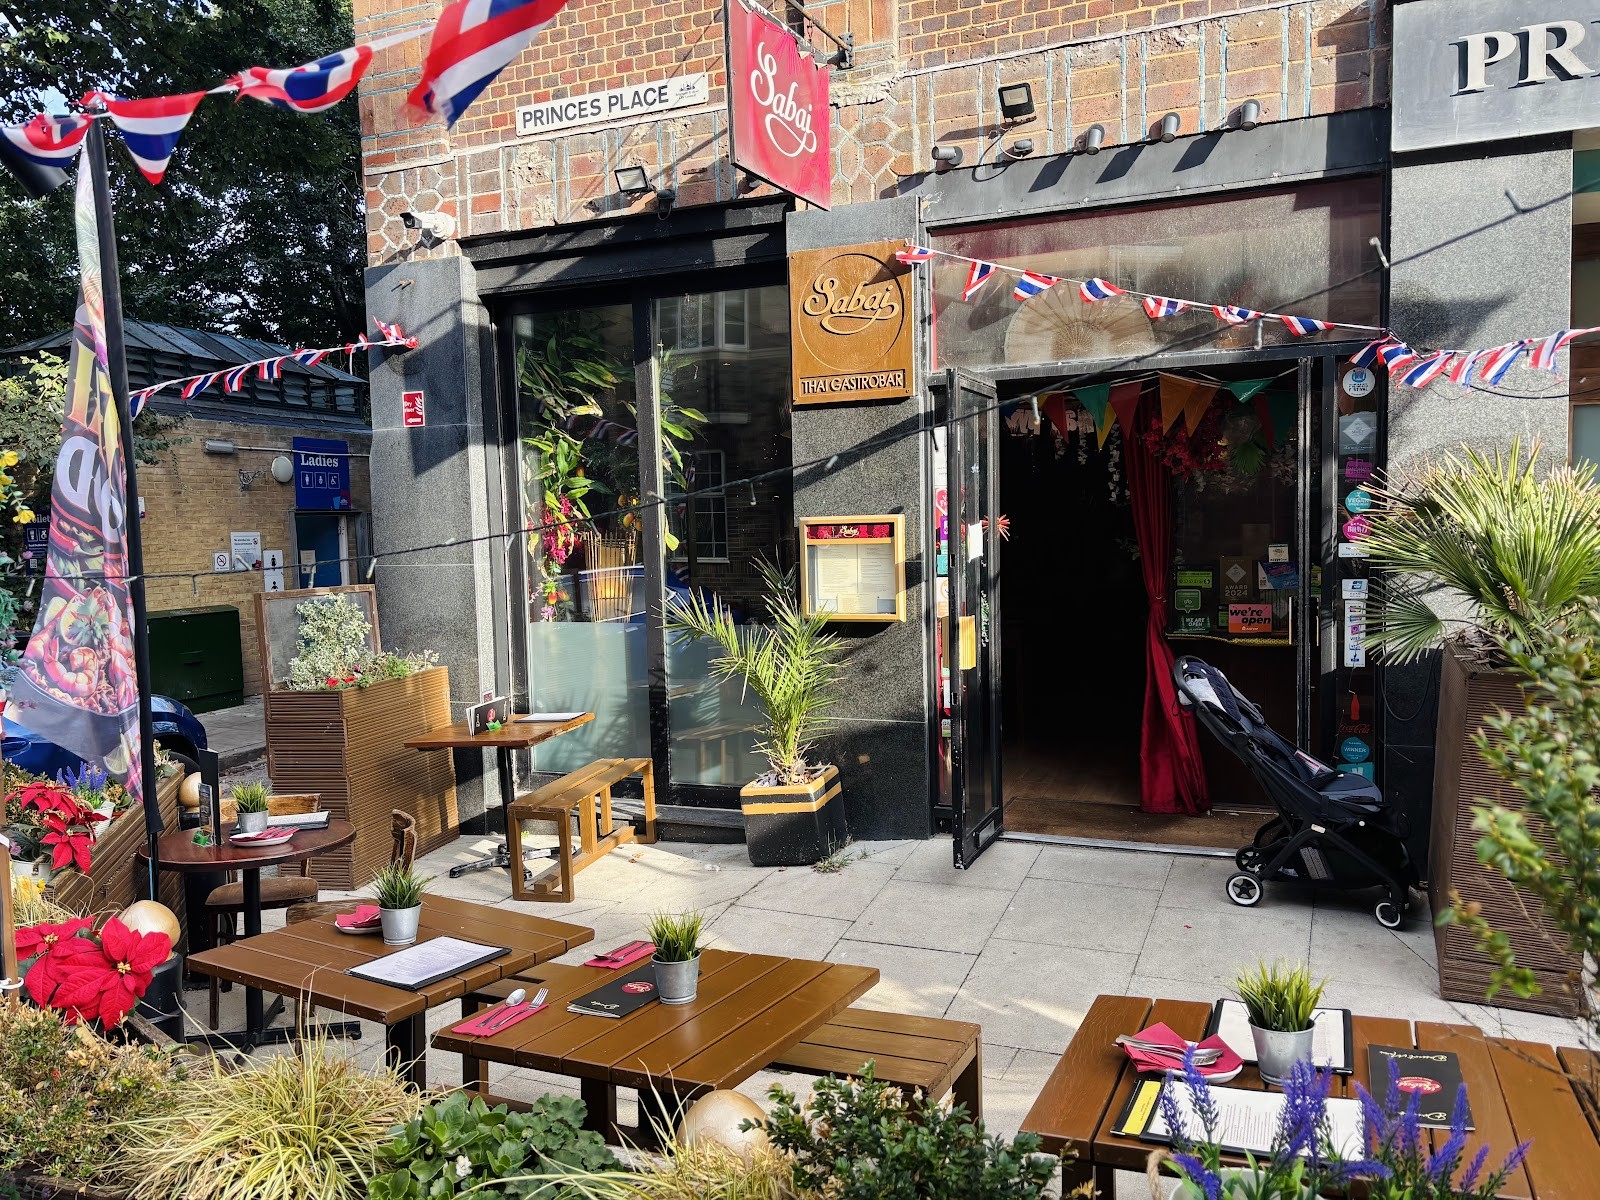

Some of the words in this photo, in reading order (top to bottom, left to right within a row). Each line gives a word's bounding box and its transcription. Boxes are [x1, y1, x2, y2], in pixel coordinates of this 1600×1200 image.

[522, 98, 601, 129] PRINCES
[608, 85, 669, 113] PLACE
[750, 41, 817, 157] Sabai
[803, 273, 899, 336] Sabai
[802, 378, 828, 394] THAI
[831, 373, 904, 391] GASTROBAR
[300, 453, 339, 467] Ladies
[1230, 608, 1263, 616] we're
[1242, 617, 1271, 626] open
